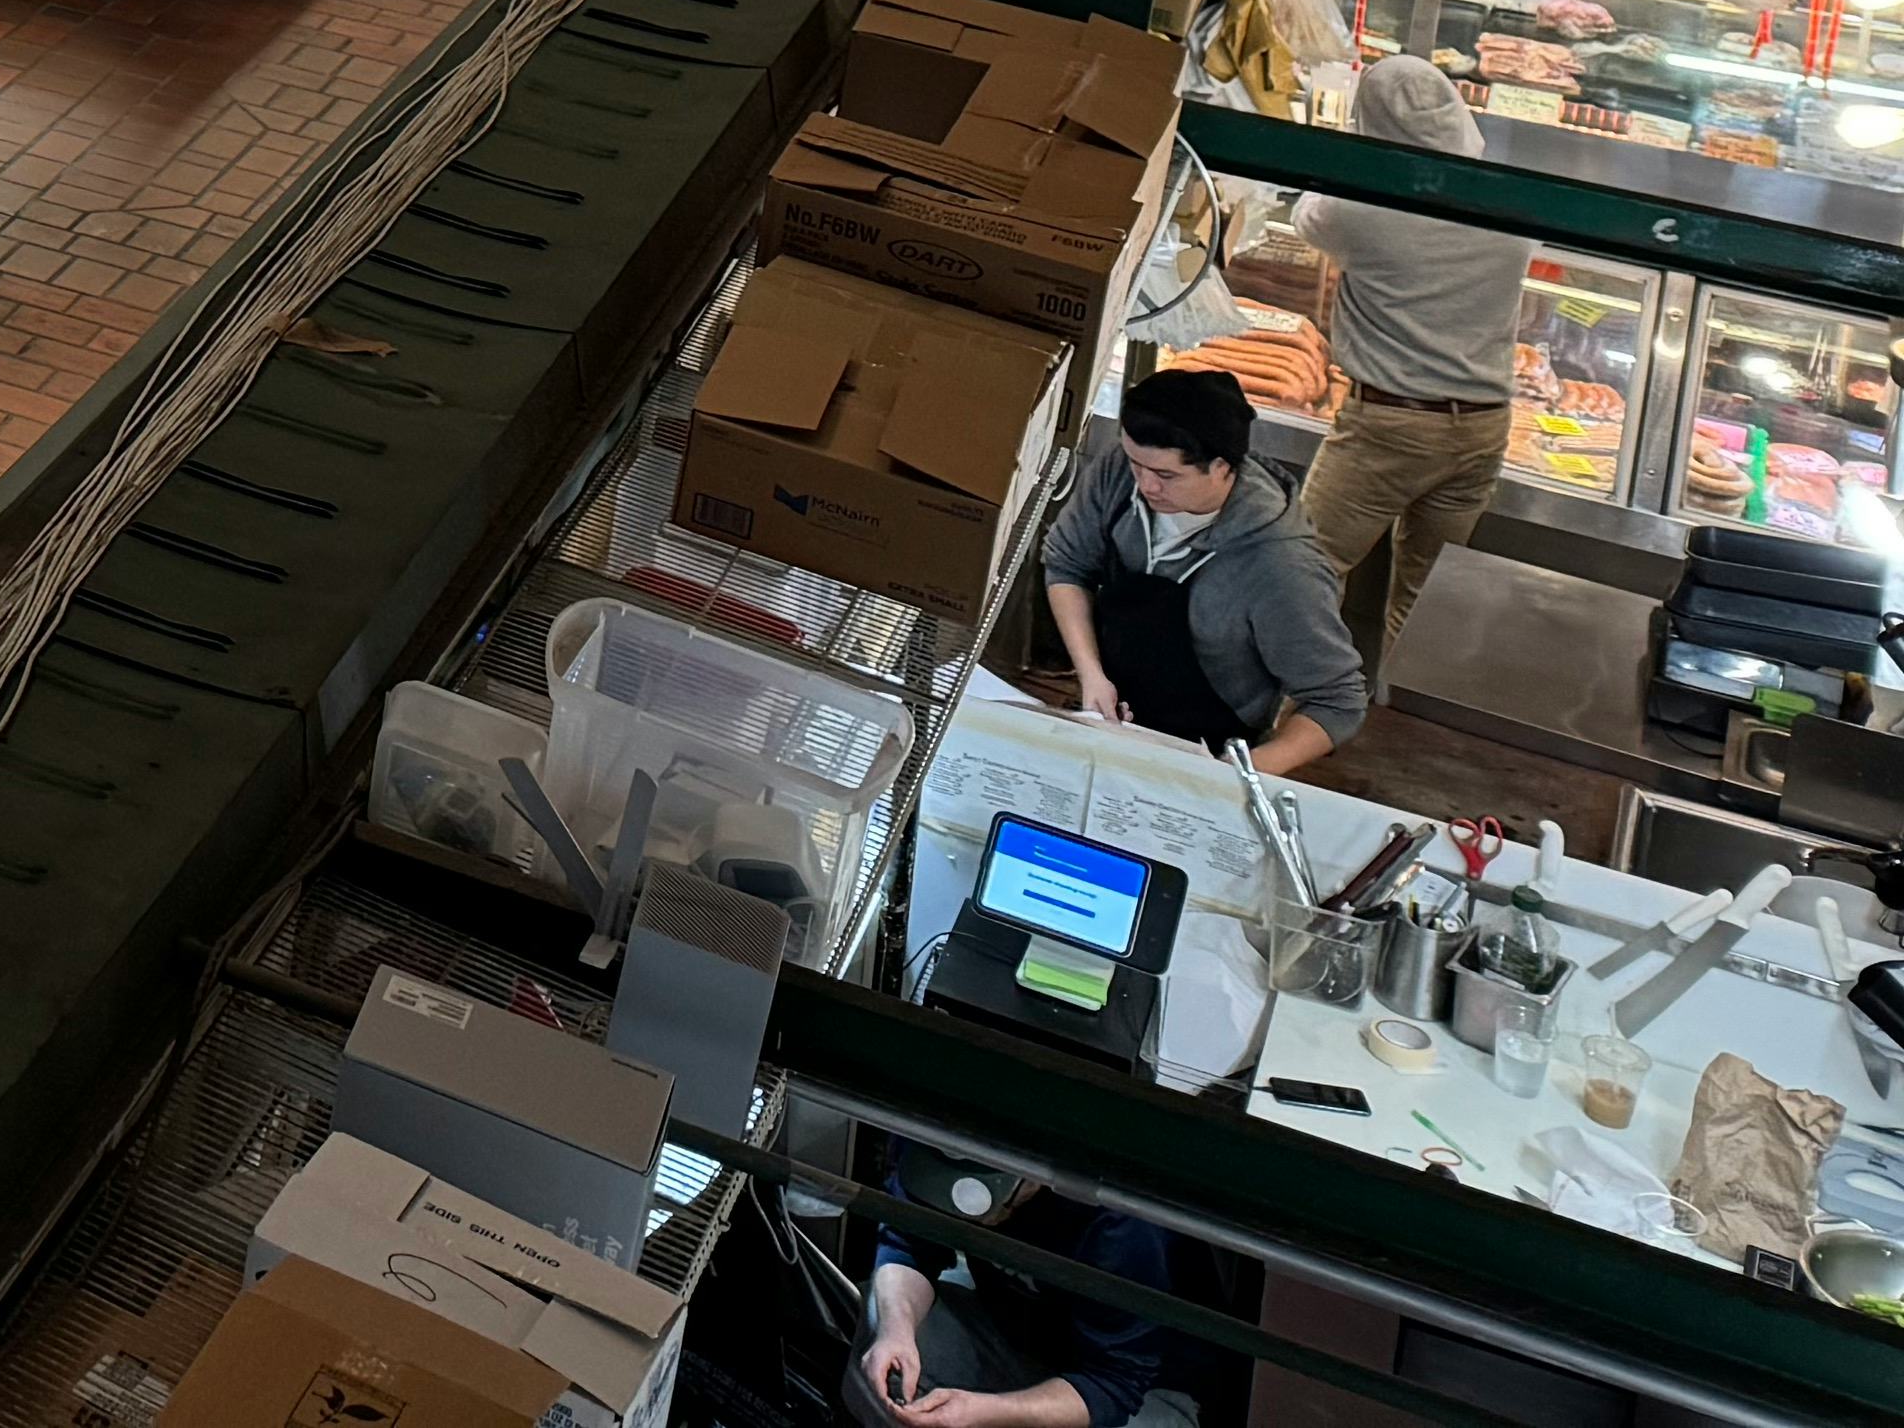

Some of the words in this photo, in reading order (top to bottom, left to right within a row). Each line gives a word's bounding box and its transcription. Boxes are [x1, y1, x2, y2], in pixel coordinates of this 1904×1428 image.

[898, 245, 972, 276] DART
[1036, 292, 1087, 322] 1000
[811, 495, 881, 529] McNairn
[422, 1201, 462, 1224] SIDE
[468, 1223, 505, 1245] THIS
[512, 1242, 561, 1269] OPEN
